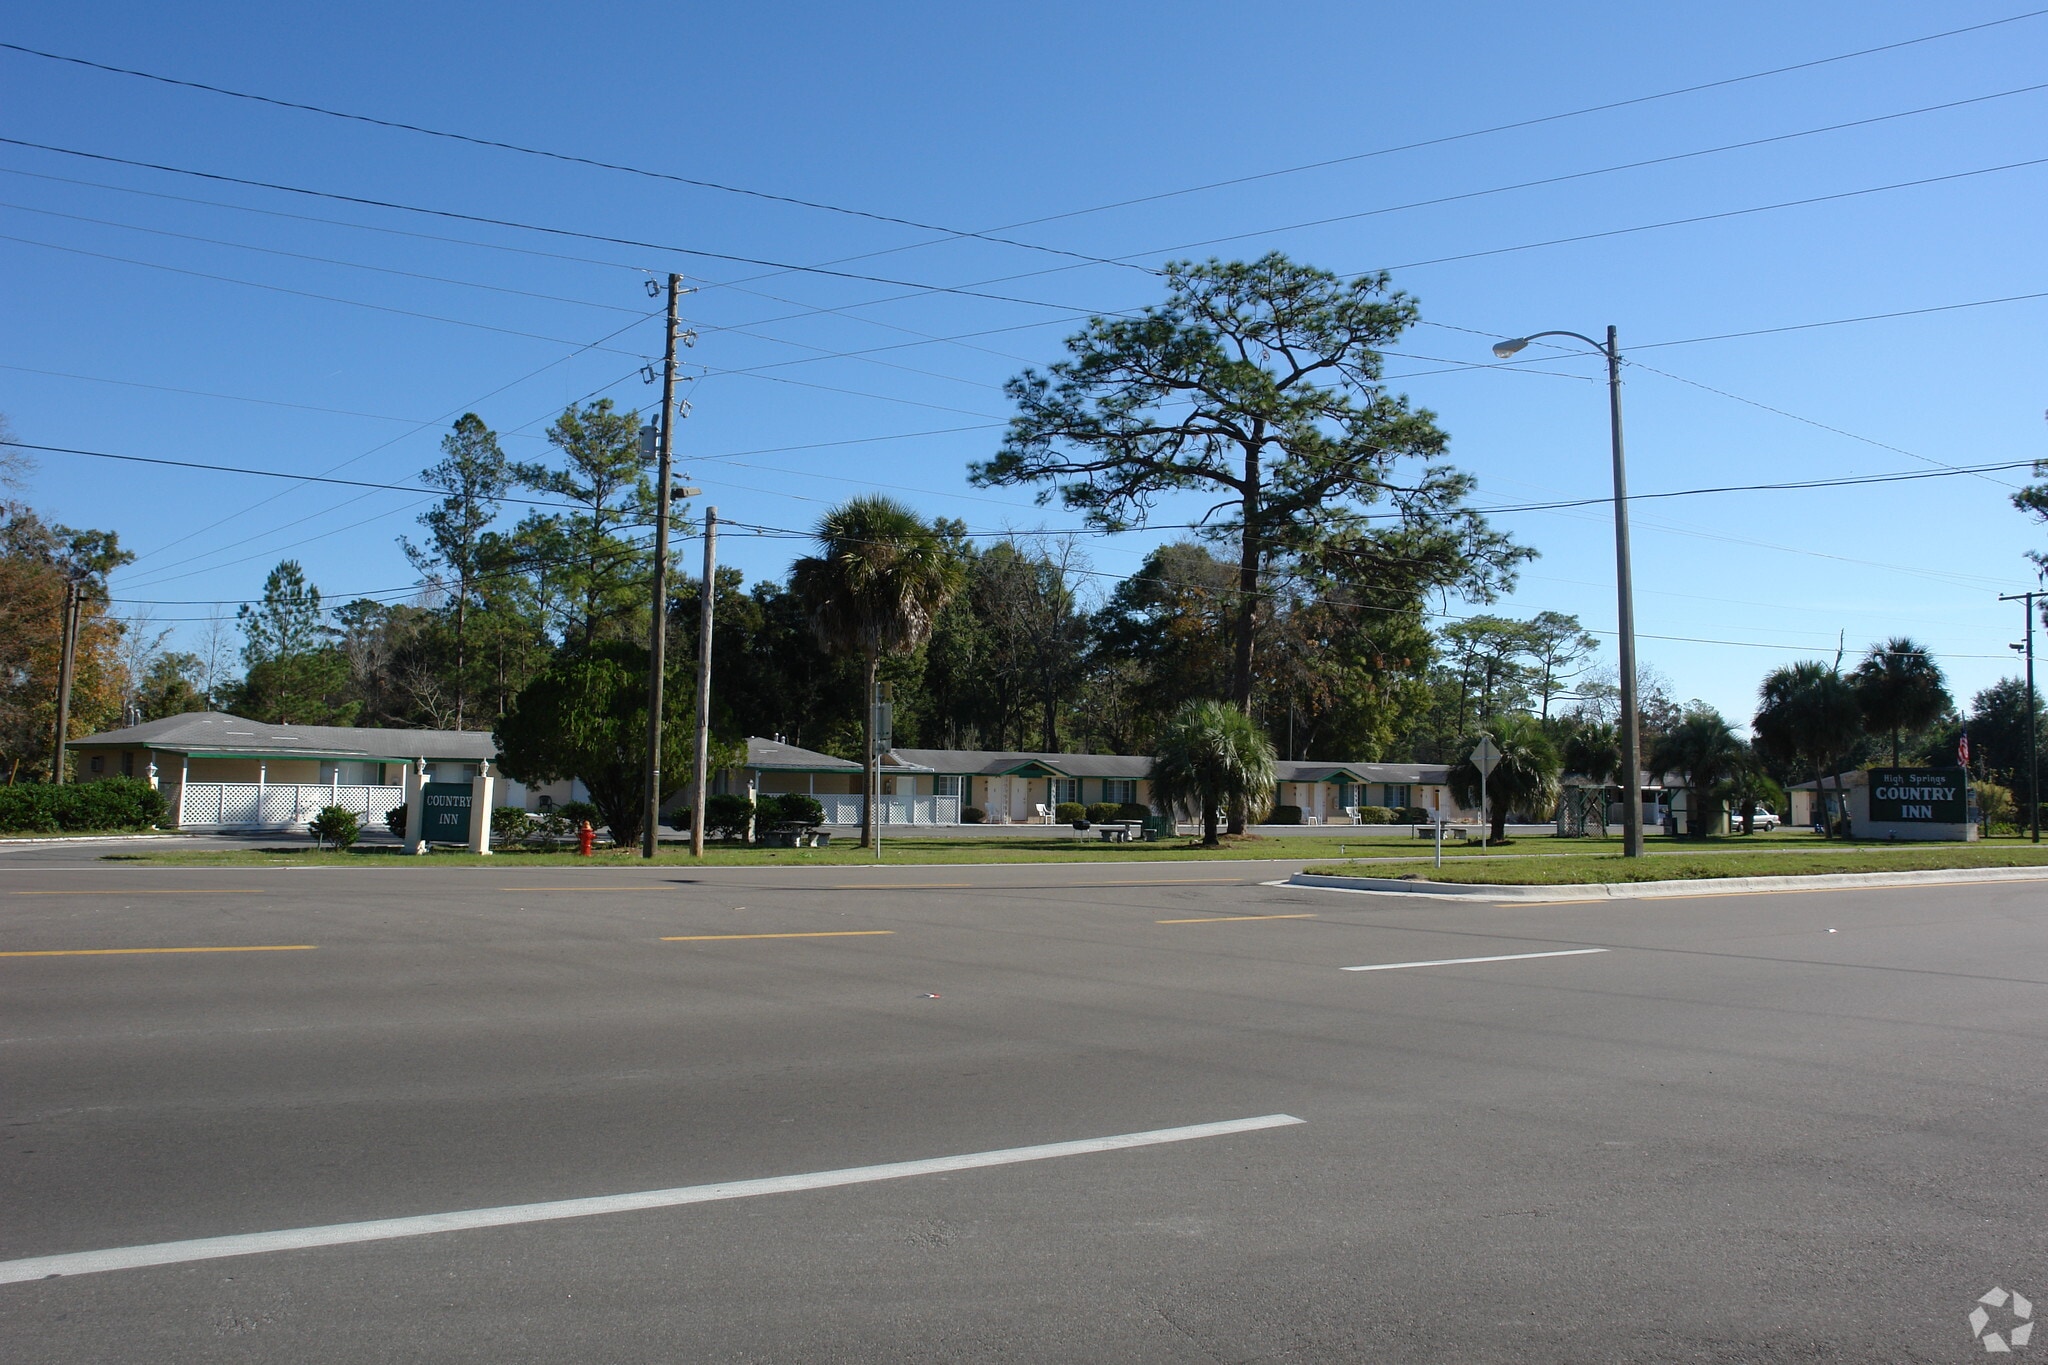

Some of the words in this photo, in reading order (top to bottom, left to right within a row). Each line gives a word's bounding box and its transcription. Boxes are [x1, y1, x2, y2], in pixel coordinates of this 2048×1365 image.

[1883, 774, 1904, 786] High
[1909, 774, 1946, 786] Springs
[1875, 786, 1956, 801] COUNTRY
[426, 795, 473, 808] COUNTRY
[1901, 804, 1933, 819] INN
[438, 813, 459, 825] INN
